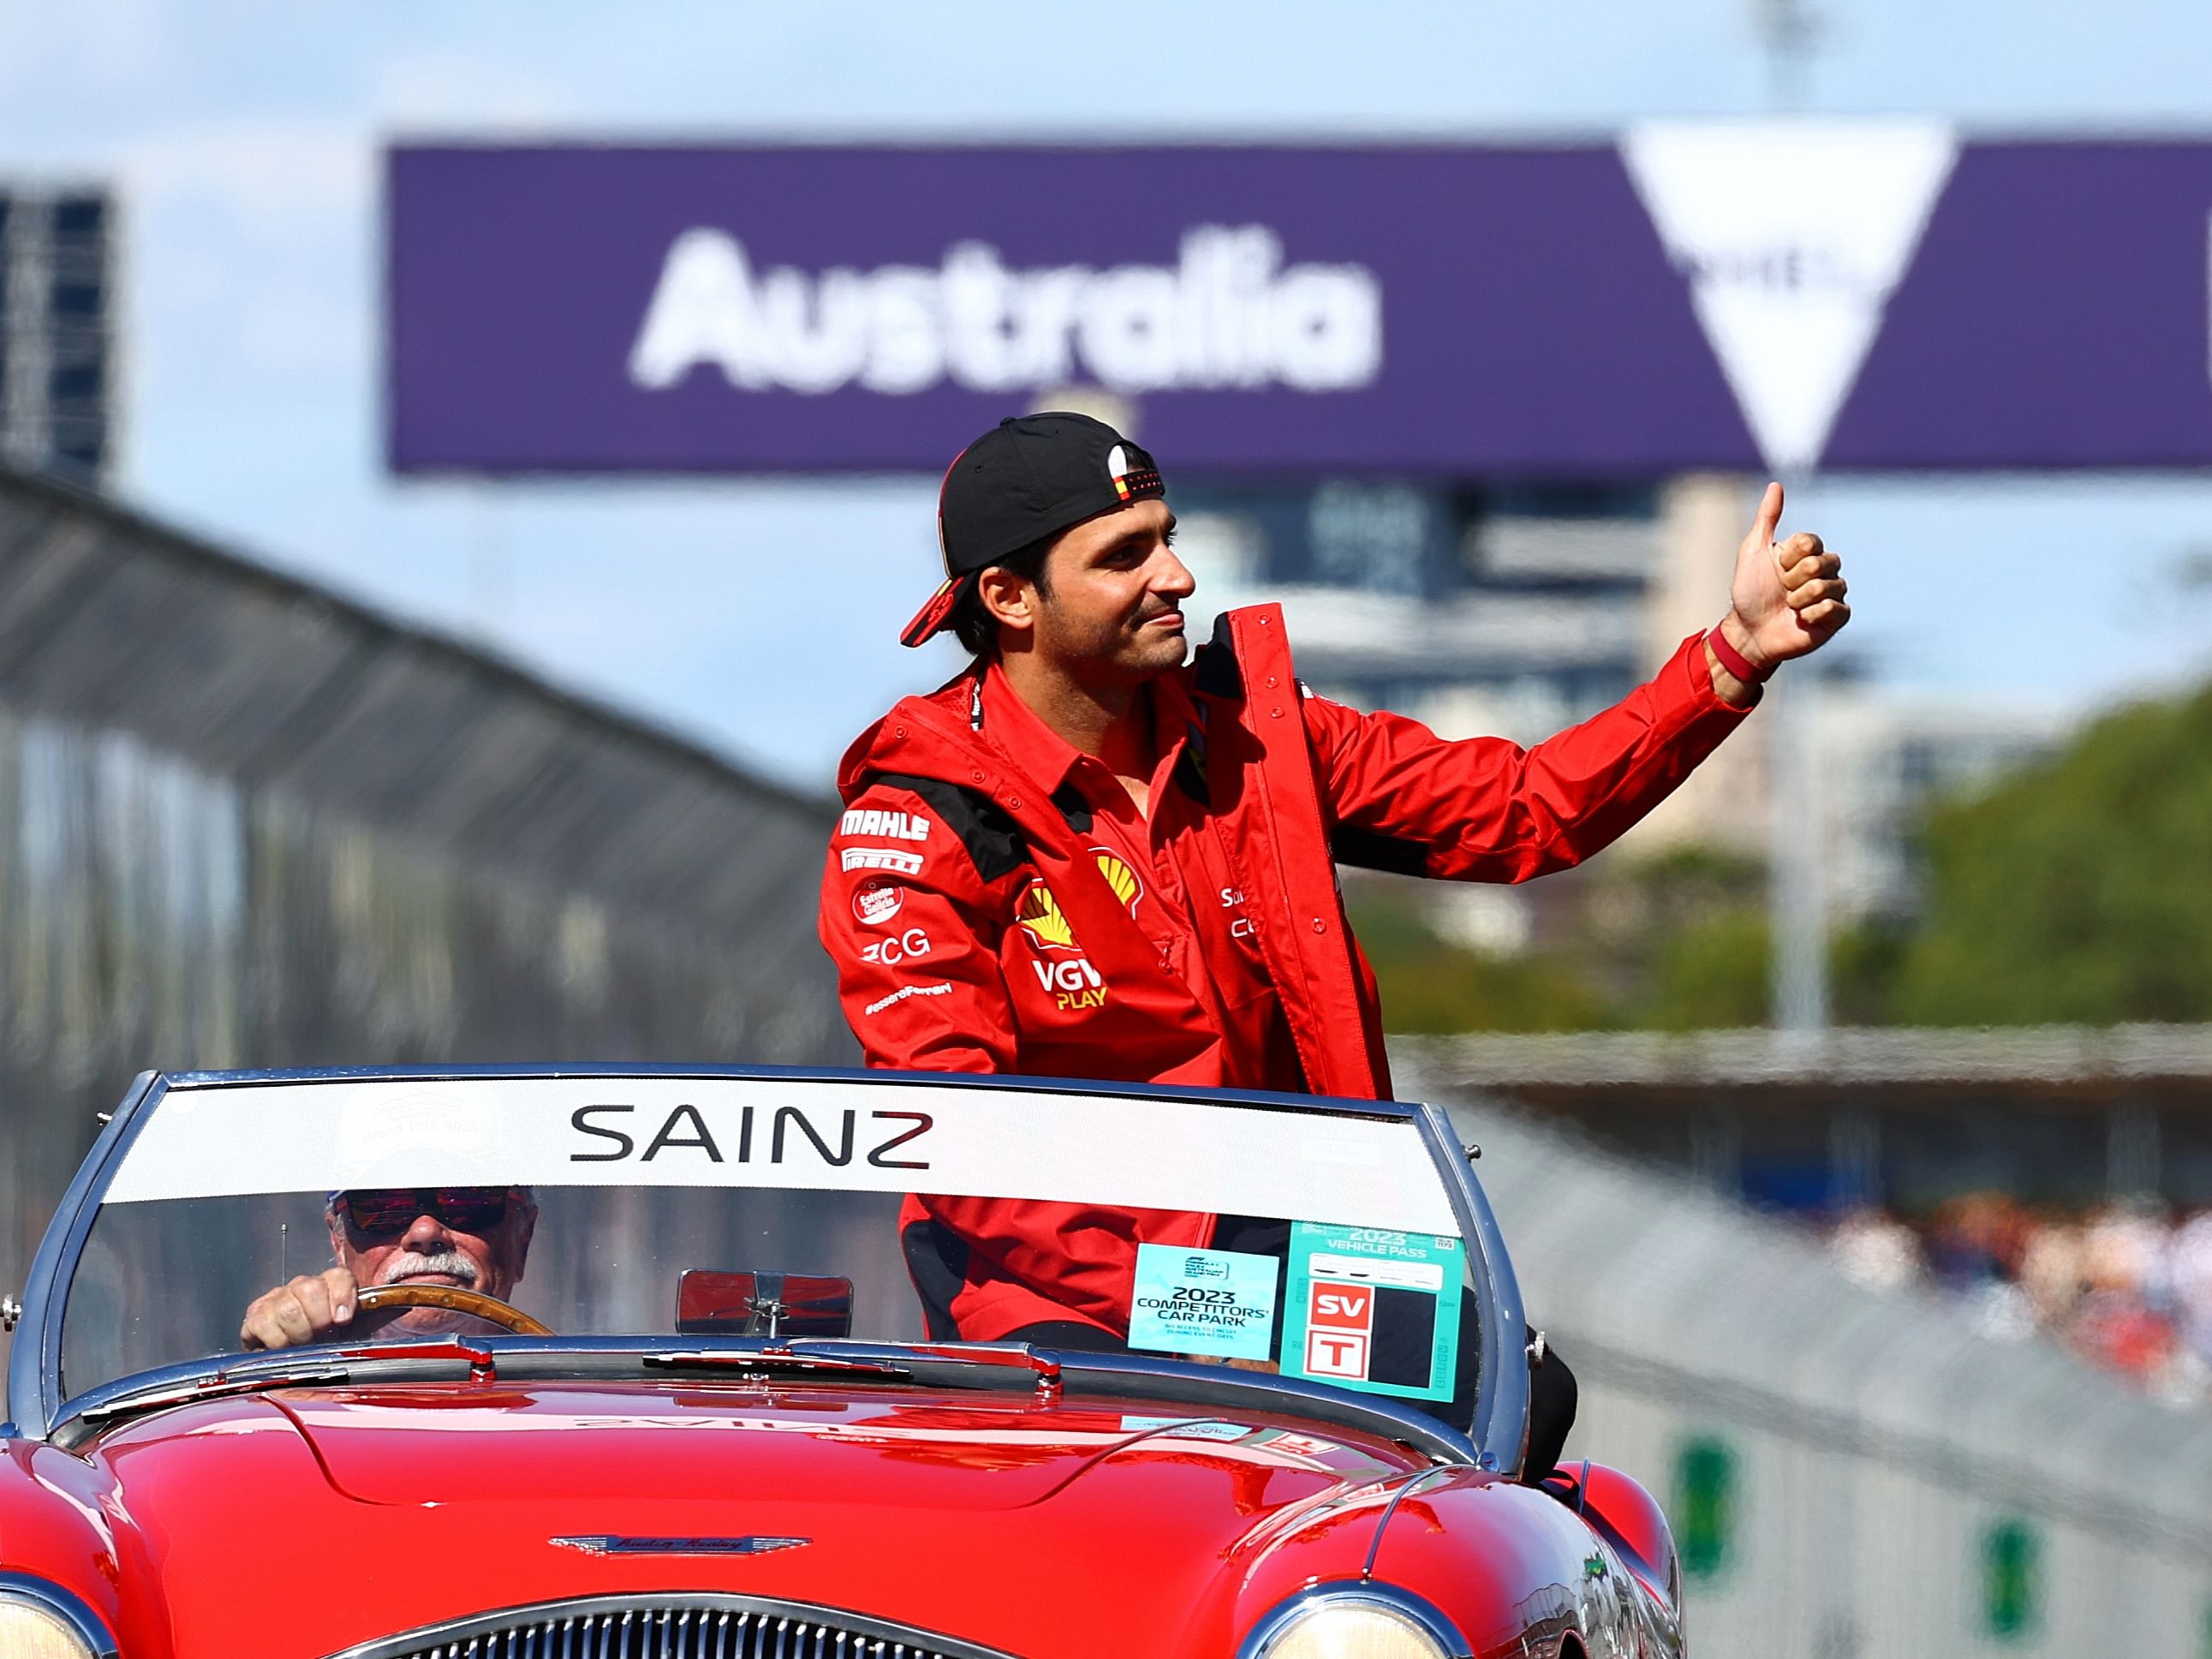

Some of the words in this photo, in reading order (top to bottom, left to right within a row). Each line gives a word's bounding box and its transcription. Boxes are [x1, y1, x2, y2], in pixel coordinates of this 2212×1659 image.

[628, 225, 1382, 394] Australia
[840, 809, 930, 841] MAHLE
[841, 847, 924, 875] PIRELLI
[859, 887, 894, 907] Estrella
[863, 897, 896, 916] Galicia
[865, 982, 952, 1016] #essereFerrari
[1056, 988, 1108, 1011] PLAY
[569, 1104, 933, 1170] SAINZ
[1327, 1238, 1386, 1255] VEHICLE
[1389, 1247, 1428, 1259] PASS
[1349, 1228, 1406, 1246] 2023
[1172, 1286, 1236, 1304] 2023
[1316, 1294, 1365, 1317] SV
[1158, 1310, 1195, 1322] CAR
[1198, 1314, 1246, 1328] PARK
[1320, 1340, 1355, 1367] T
